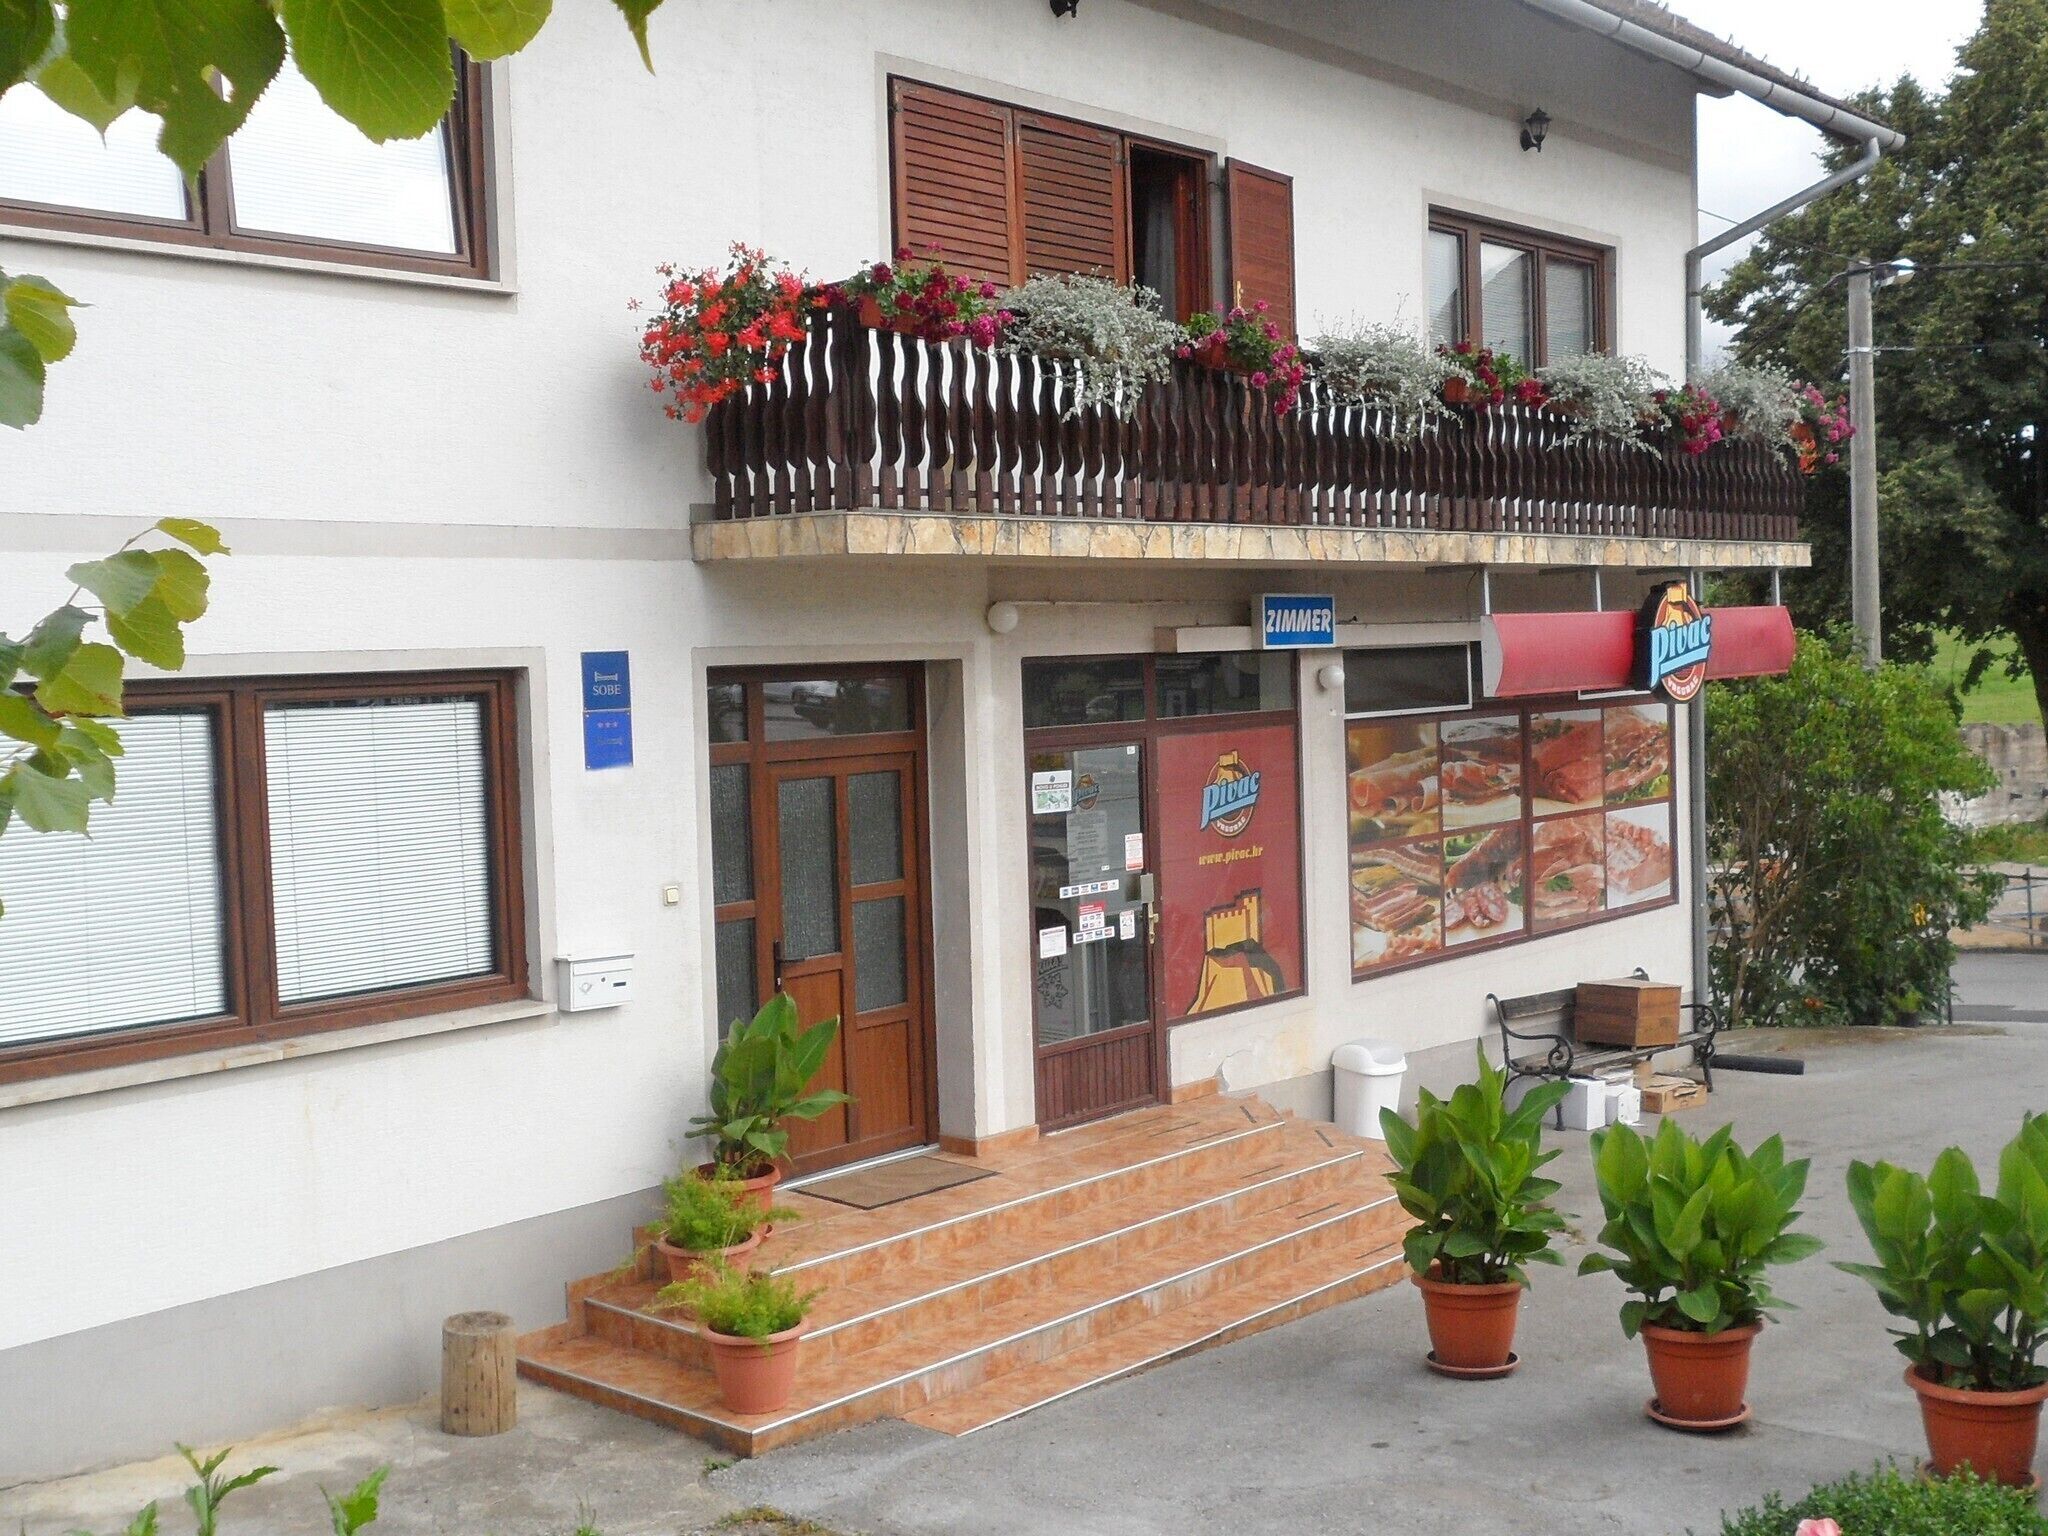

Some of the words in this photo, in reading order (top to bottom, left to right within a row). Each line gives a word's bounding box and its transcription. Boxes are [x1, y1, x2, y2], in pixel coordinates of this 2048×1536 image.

[1266, 608, 1332, 633] ZIMMER
[592, 684, 622, 696] SOBE
[1199, 845, 1264, 865] www.pivac.hr
